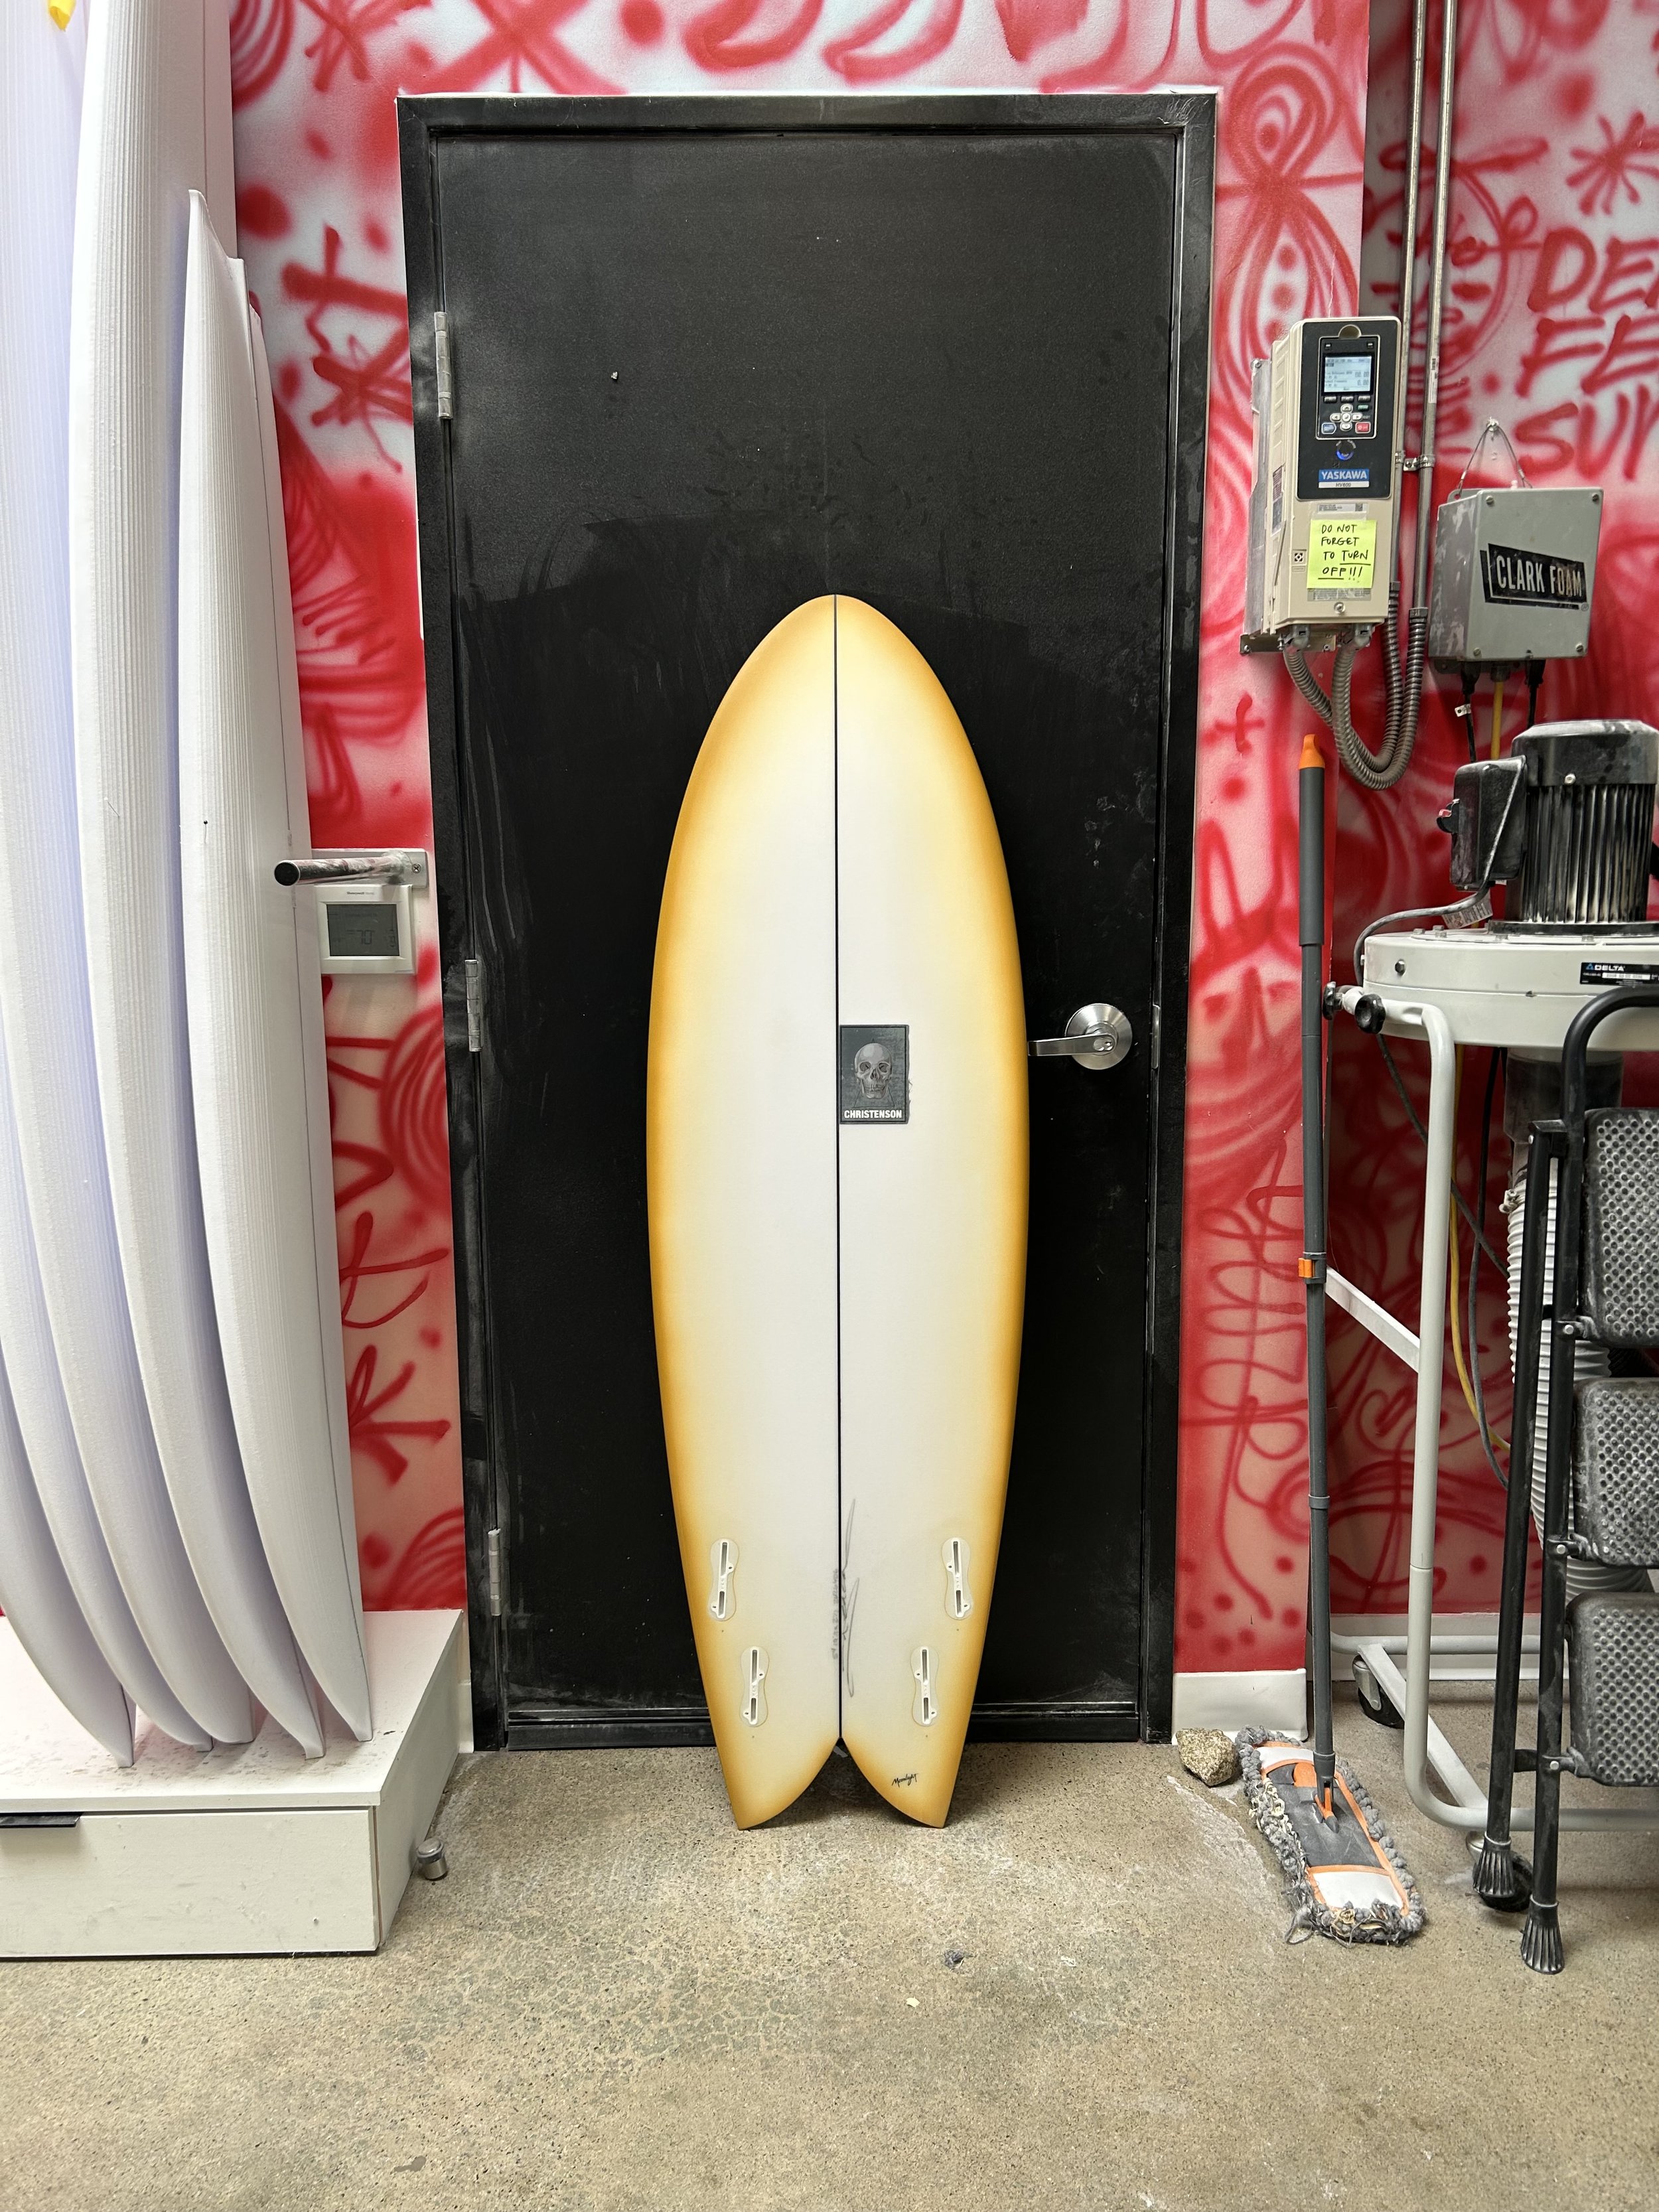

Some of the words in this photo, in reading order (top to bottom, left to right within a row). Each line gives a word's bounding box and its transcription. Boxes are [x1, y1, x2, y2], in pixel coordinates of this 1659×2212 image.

[1321, 471, 1367, 479] YASKAWA
[1321, 524, 1333, 534] DO
[1336, 524, 1357, 534] NOT
[1321, 536, 1360, 546] FORGET
[1323, 551, 1334, 560] TO
[1342, 550, 1368, 561] TURN
[1496, 555, 1545, 593] CLARK
[1550, 565, 1582, 597] FOAM
[843, 1110, 902, 1118] CHRISTENSON
